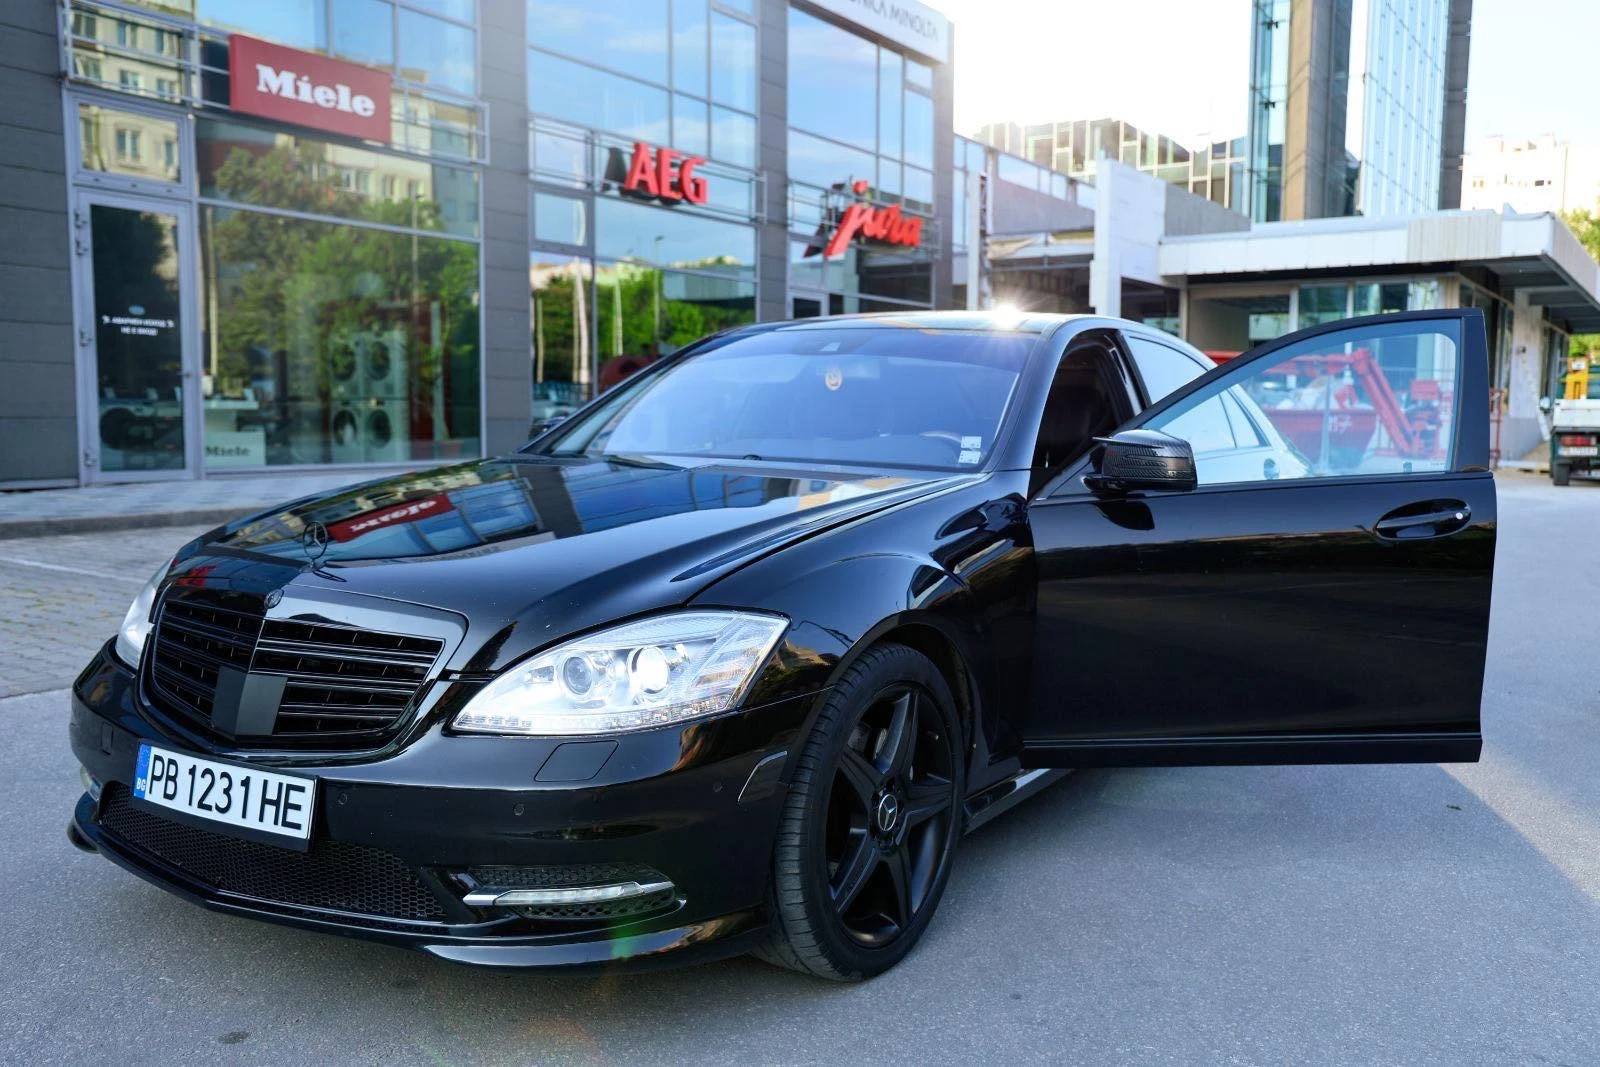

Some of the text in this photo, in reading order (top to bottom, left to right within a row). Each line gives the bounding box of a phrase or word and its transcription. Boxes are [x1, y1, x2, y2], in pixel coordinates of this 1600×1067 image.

[889, 3, 939, 41] MINOLTA
[255, 63, 376, 117] Miele
[624, 141, 708, 205] AEG
[823, 179, 924, 259] jura
[136, 776, 147, 791] BG
[149, 753, 306, 831] PB 1231 HE
